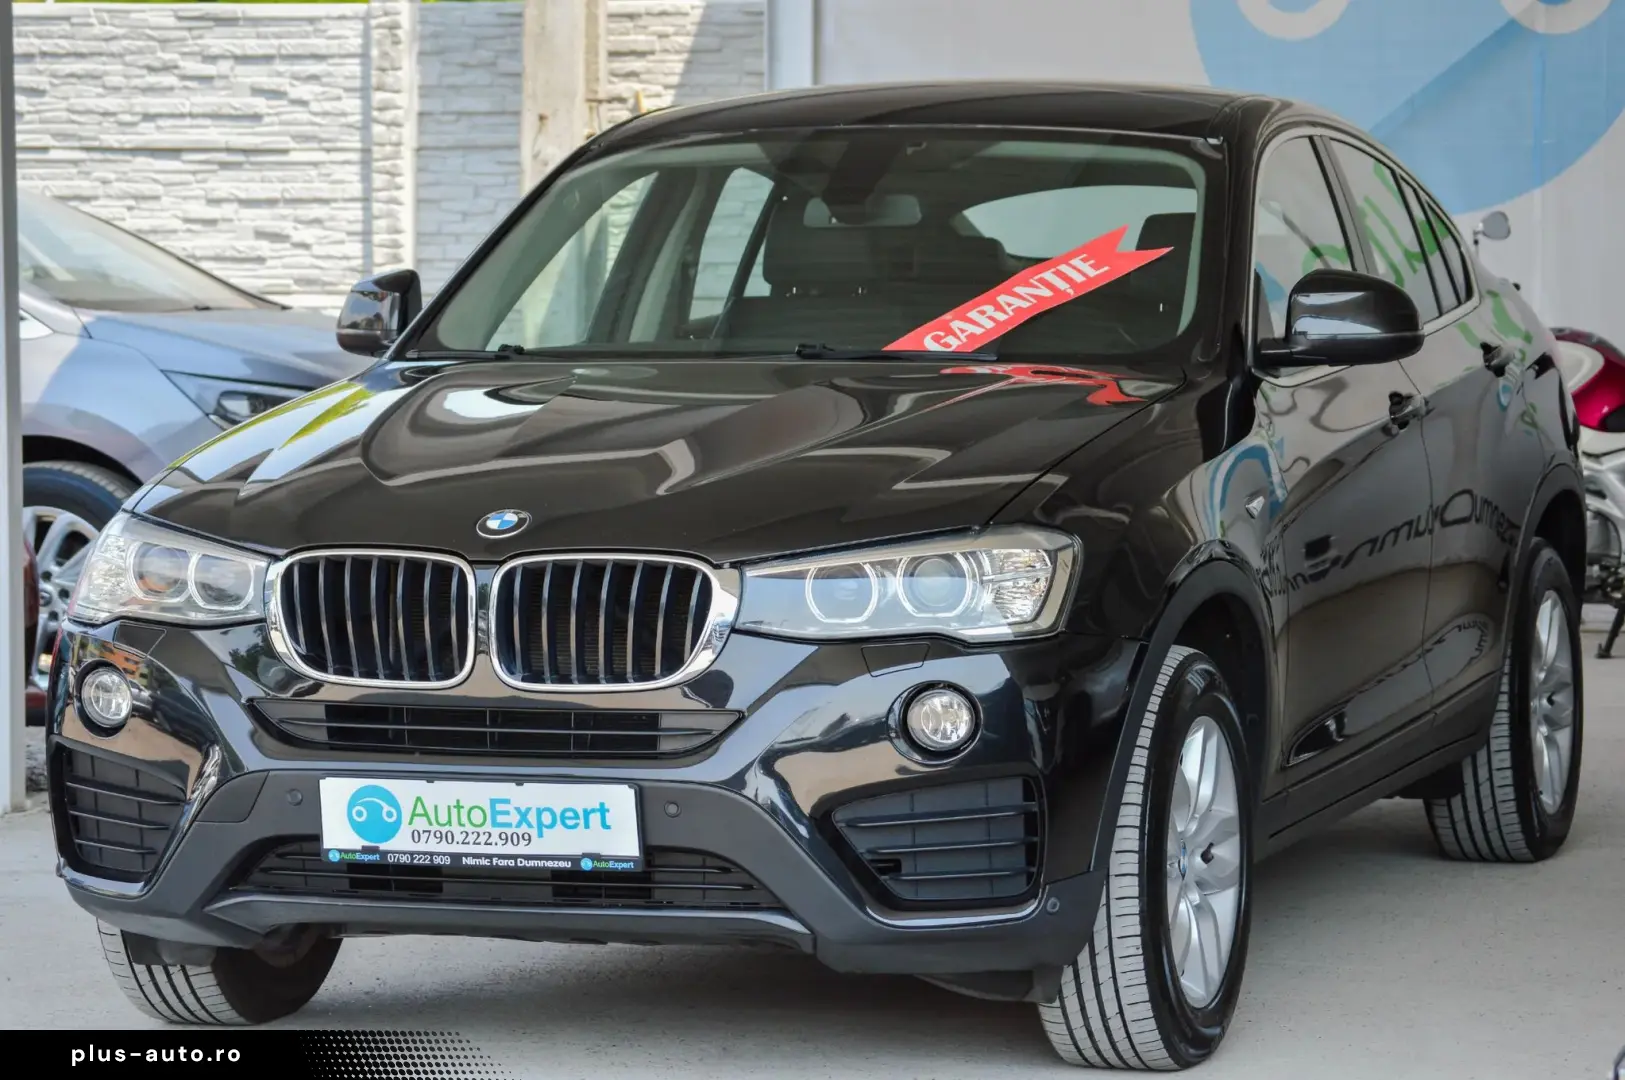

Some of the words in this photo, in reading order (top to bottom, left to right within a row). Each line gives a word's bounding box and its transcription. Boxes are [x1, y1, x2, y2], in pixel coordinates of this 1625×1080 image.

[408, 795, 612, 838] AutoExpert
[411, 829, 532, 847] 0790.222.909
[340, 851, 380, 862] AutoExpert
[387, 853, 411, 864] 0790
[413, 854, 431, 864] 222
[432, 855, 451, 865] 909
[462, 856, 491, 866] Nimic
[493, 857, 515, 867] Fara
[517, 858, 572, 868] Dumnezeu
[592, 860, 635, 870] AutoExpert
